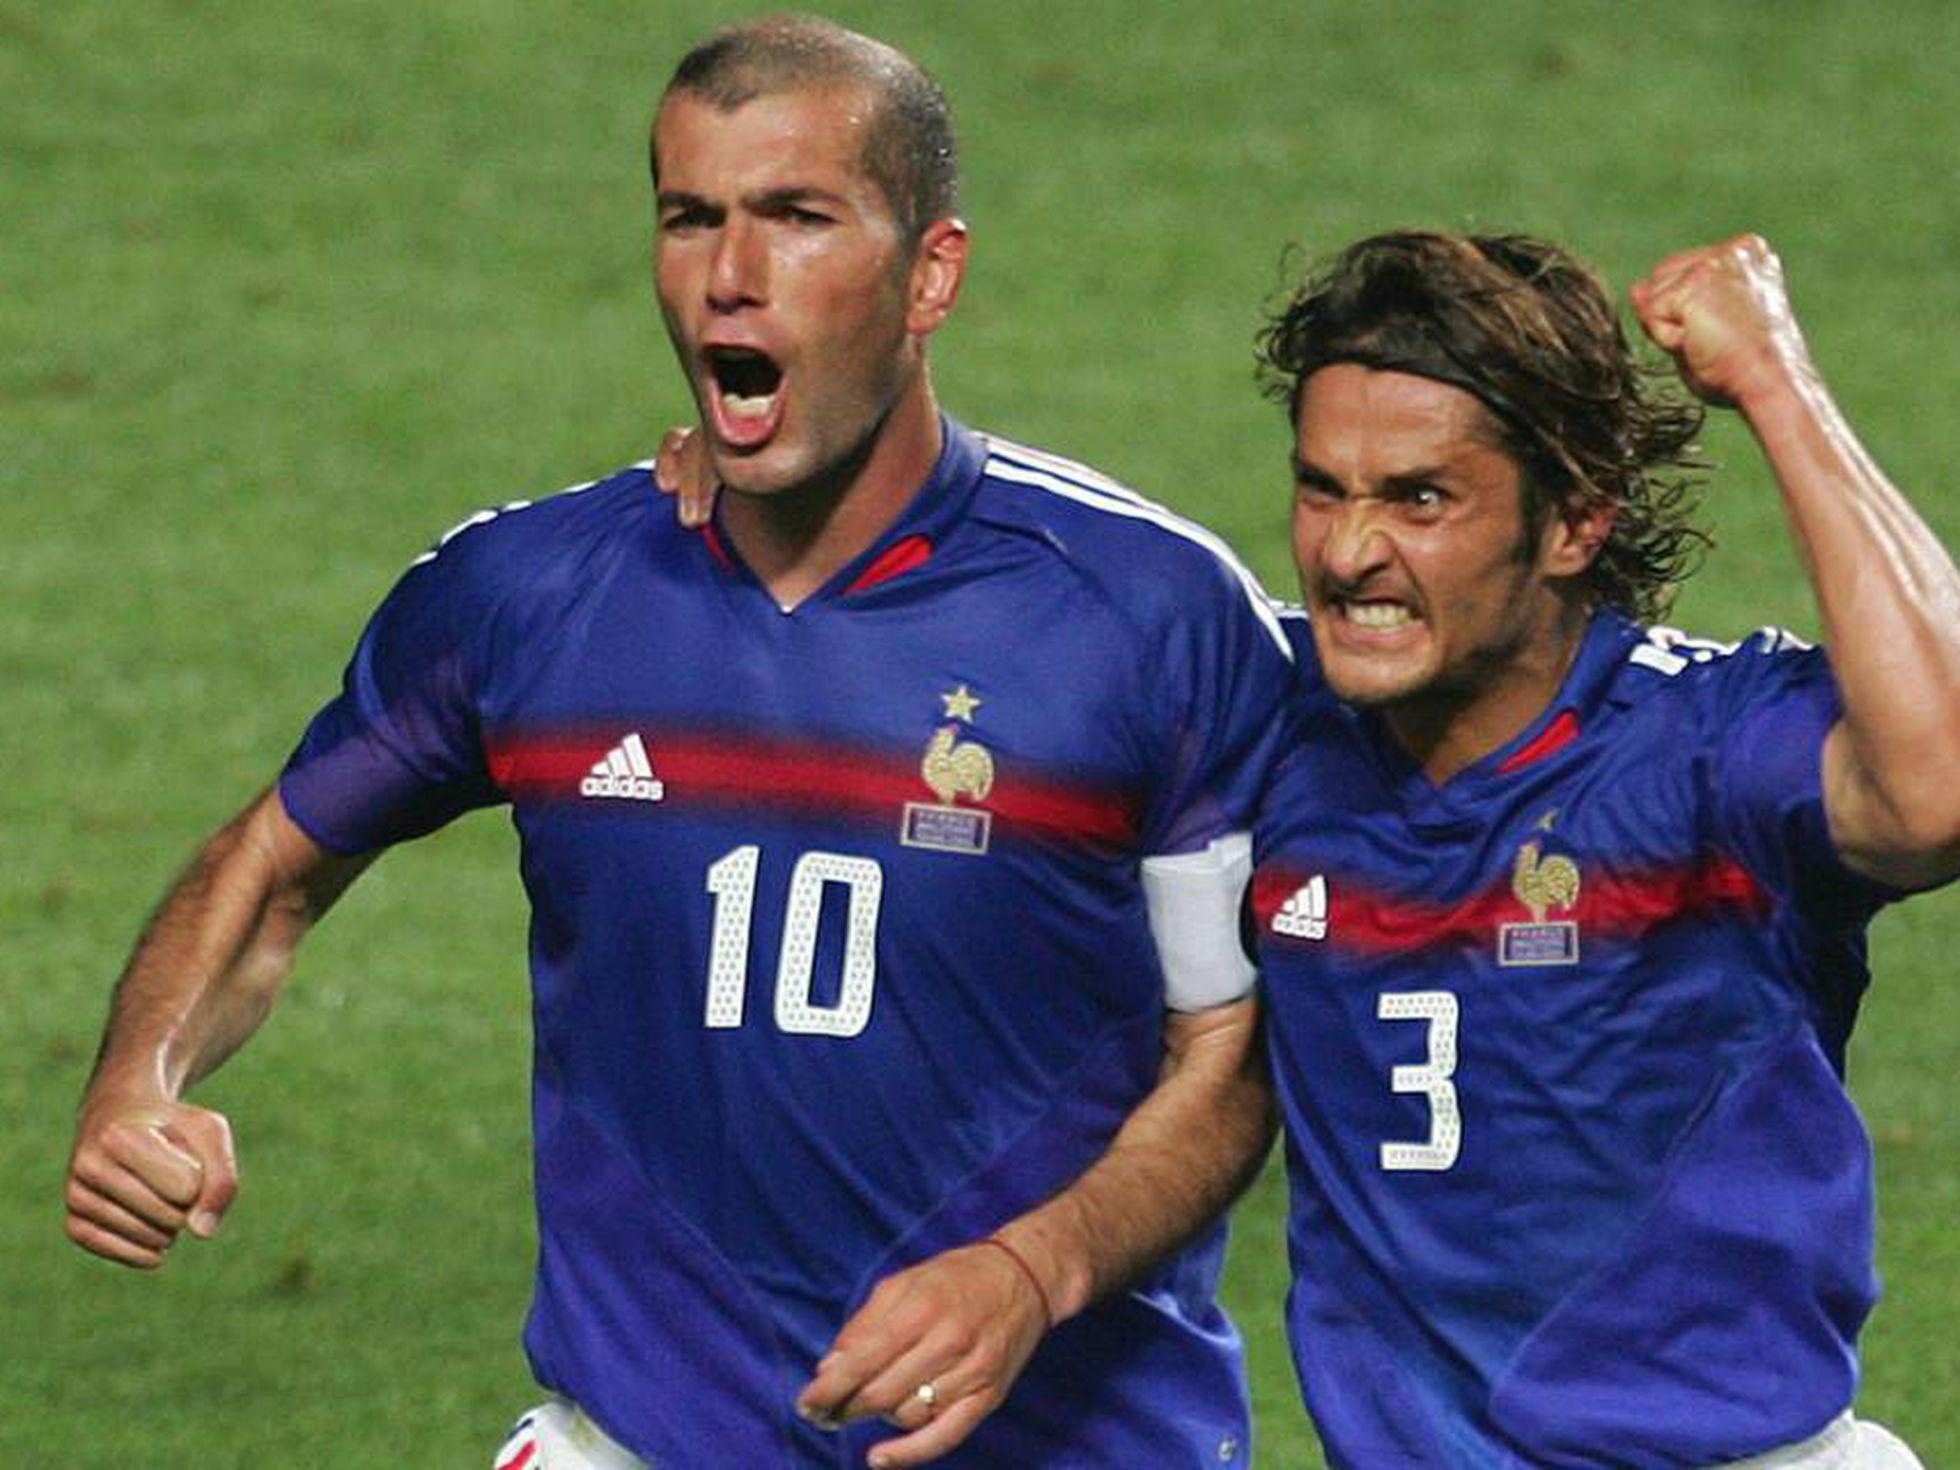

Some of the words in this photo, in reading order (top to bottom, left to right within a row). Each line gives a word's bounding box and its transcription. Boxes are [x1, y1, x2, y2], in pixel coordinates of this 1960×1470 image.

[580, 774, 664, 801] adidas
[705, 845, 884, 1038] 10
[1377, 991, 1462, 1171] 3
